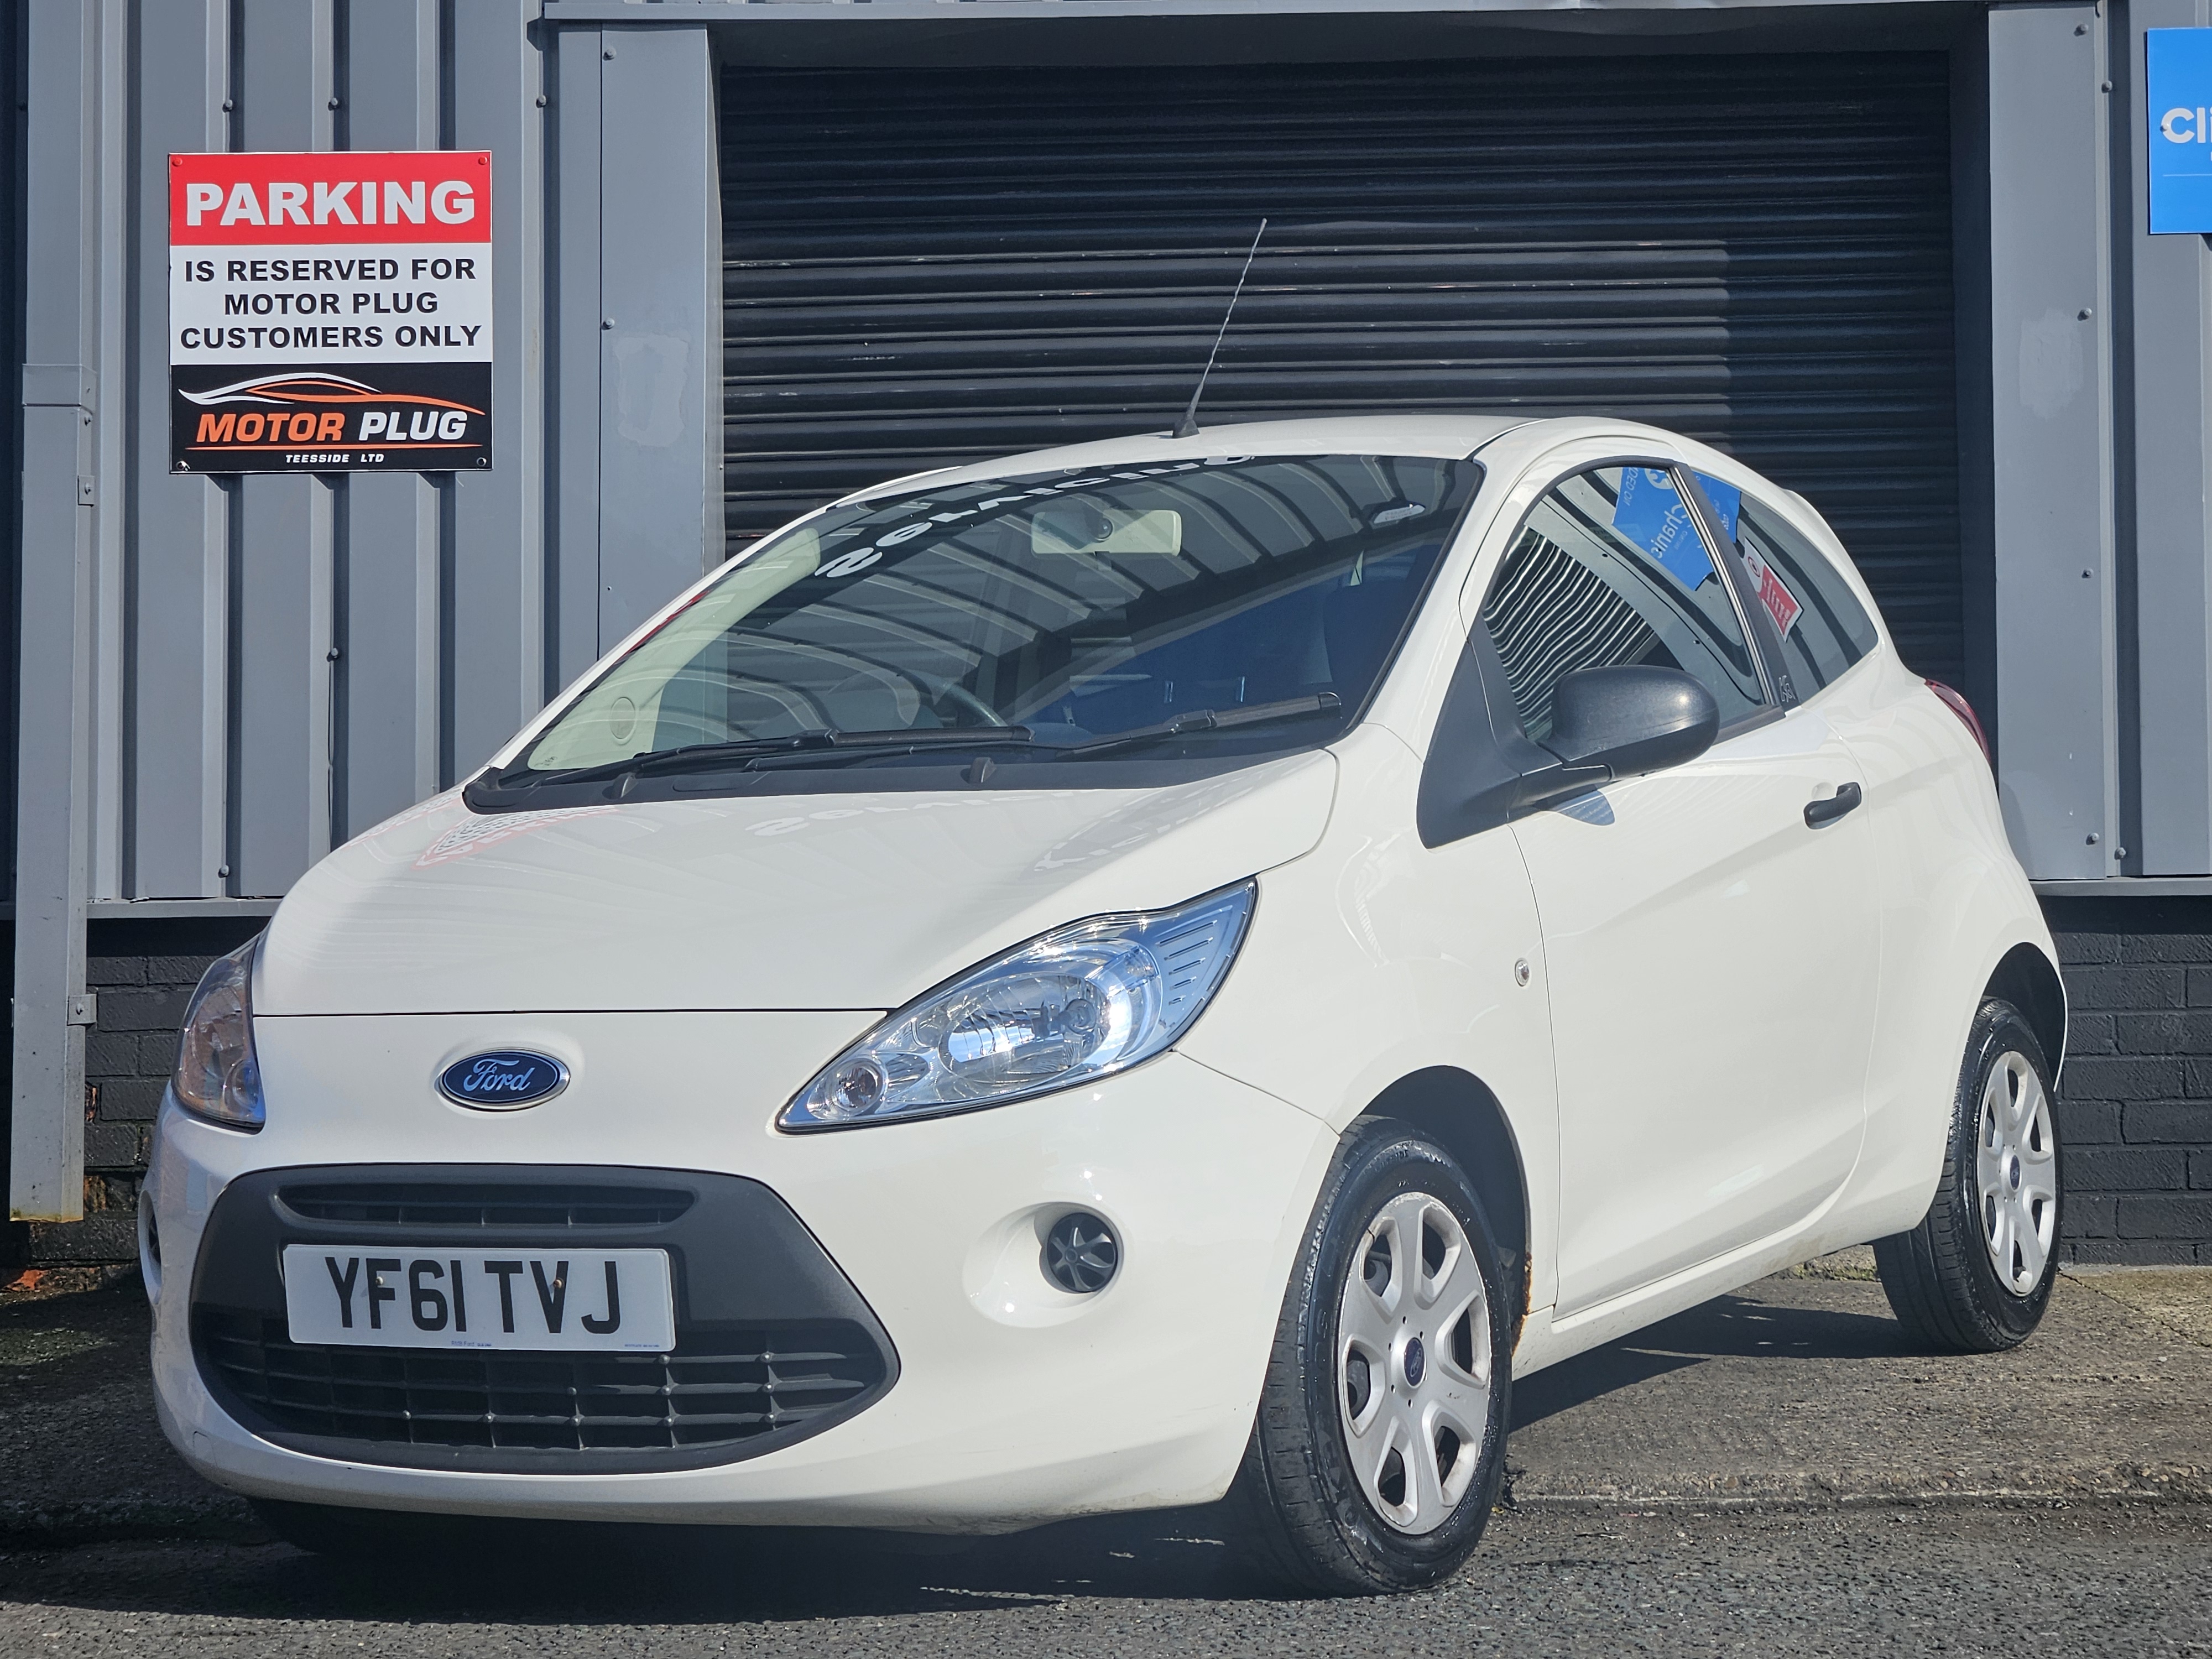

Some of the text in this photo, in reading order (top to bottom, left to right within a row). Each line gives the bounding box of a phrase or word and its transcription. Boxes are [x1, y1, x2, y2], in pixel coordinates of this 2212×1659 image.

[186, 180, 474, 226] PARKING
[186, 258, 476, 282] IS RESERVED FOR
[225, 292, 437, 315] MOTOR PLUG
[181, 325, 482, 349] CUSTOMERS ONLY
[196, 411, 467, 443] MOTOR PLUG
[285, 453, 384, 463] TEESSIDE LTD
[463, 1058, 536, 1092] Ford
[325, 1256, 621, 1334] YF61 TVJ
